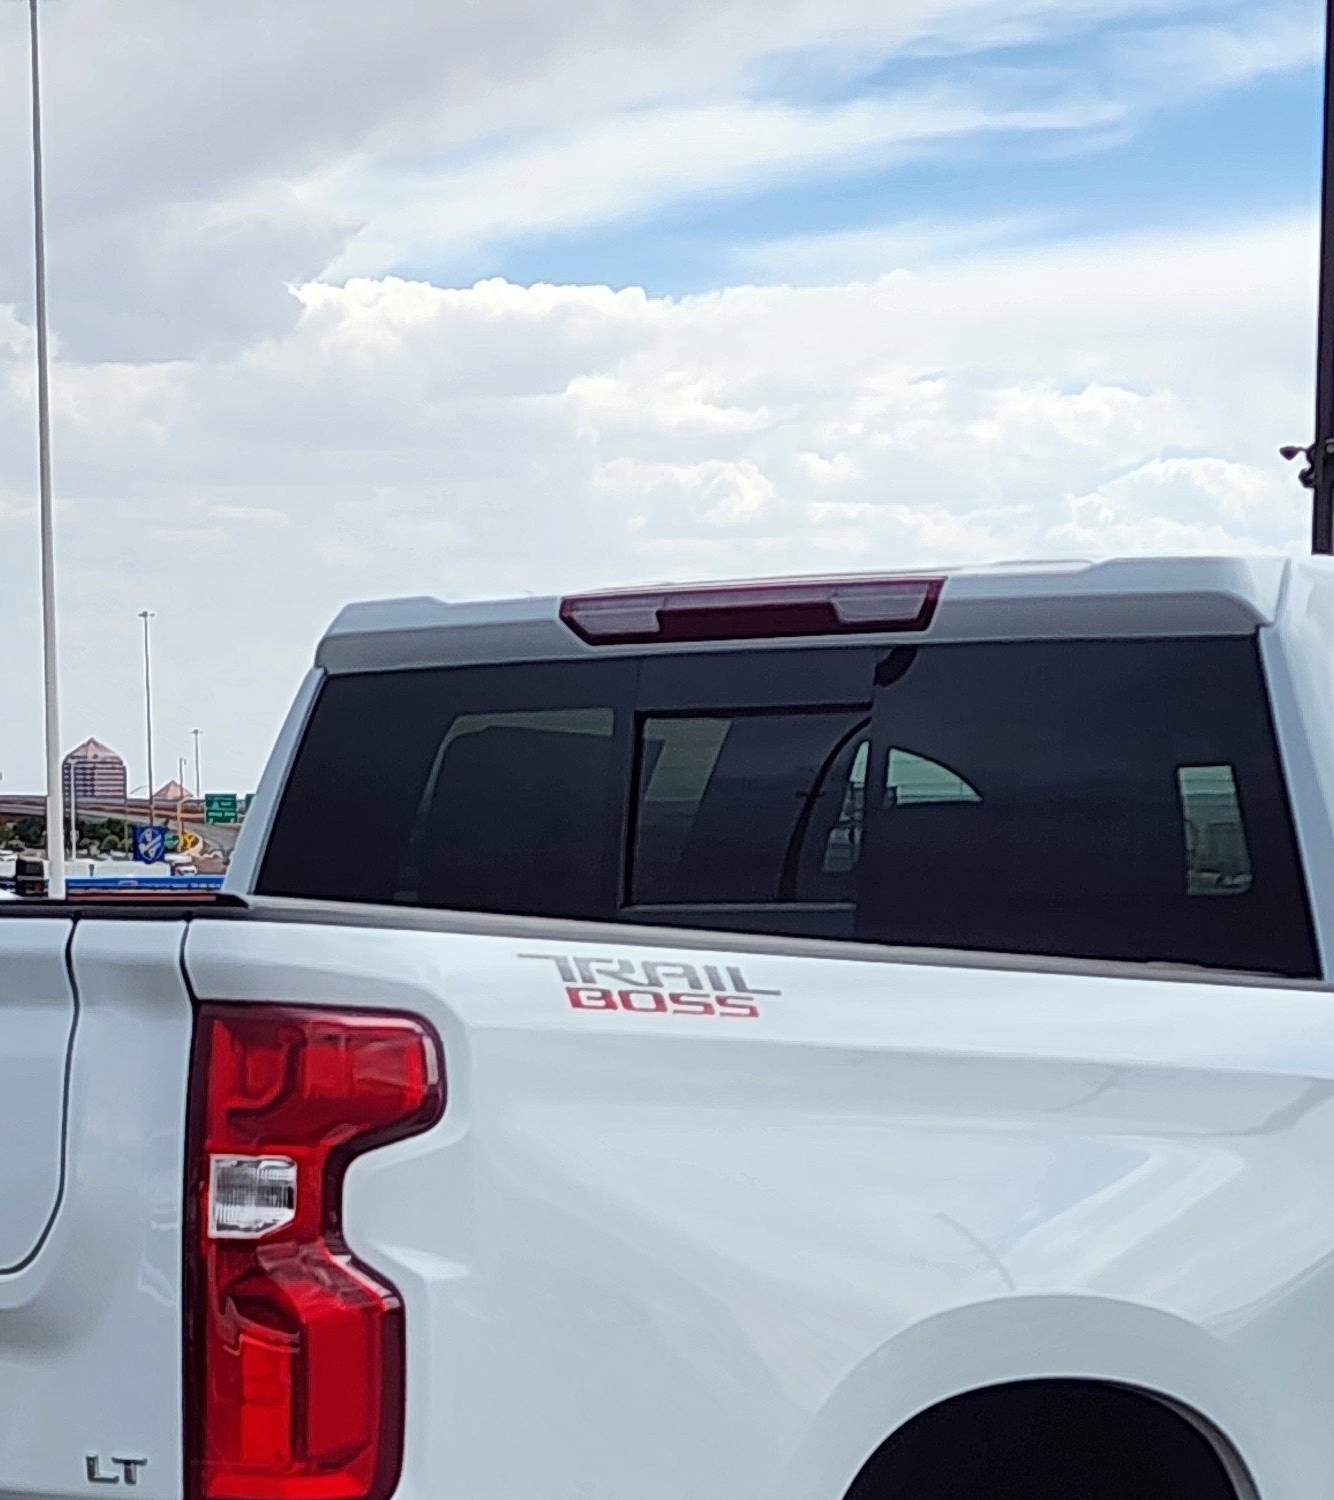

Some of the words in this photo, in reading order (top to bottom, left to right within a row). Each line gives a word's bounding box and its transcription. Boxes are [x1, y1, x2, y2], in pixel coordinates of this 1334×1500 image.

[517, 953, 781, 995] TRAIL
[565, 987, 759, 1018] BOSS
[86, 1455, 148, 1485] LT
